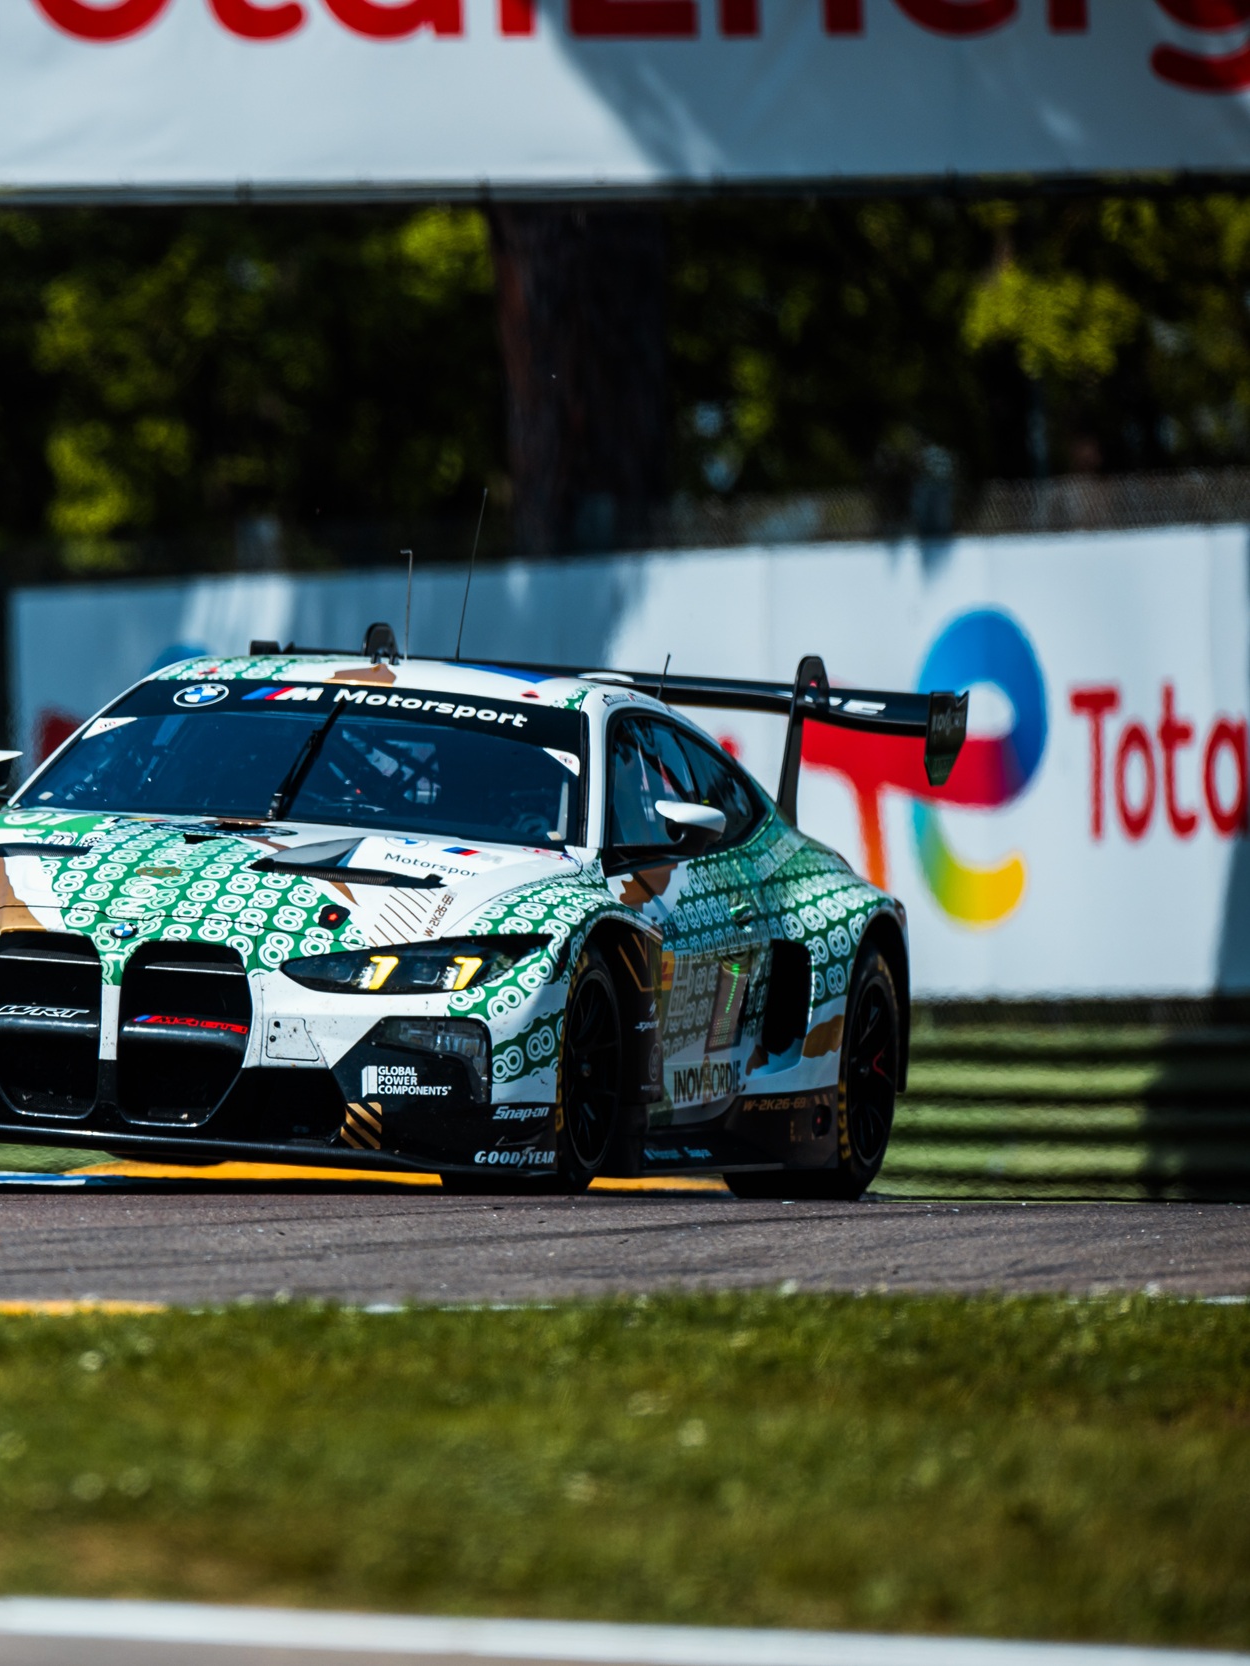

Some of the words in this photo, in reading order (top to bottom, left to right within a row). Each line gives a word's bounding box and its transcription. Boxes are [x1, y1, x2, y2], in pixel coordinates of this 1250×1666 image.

[333, 687, 528, 728] Motorsport
[377, 1066, 418, 1077] GLOBAL
[377, 1075, 418, 1086] POWER
[742, 1097, 812, 1112] W-2K26-69
[492, 1105, 550, 1122] Snap-on
[474, 1148, 556, 1167] GOODYEAR
